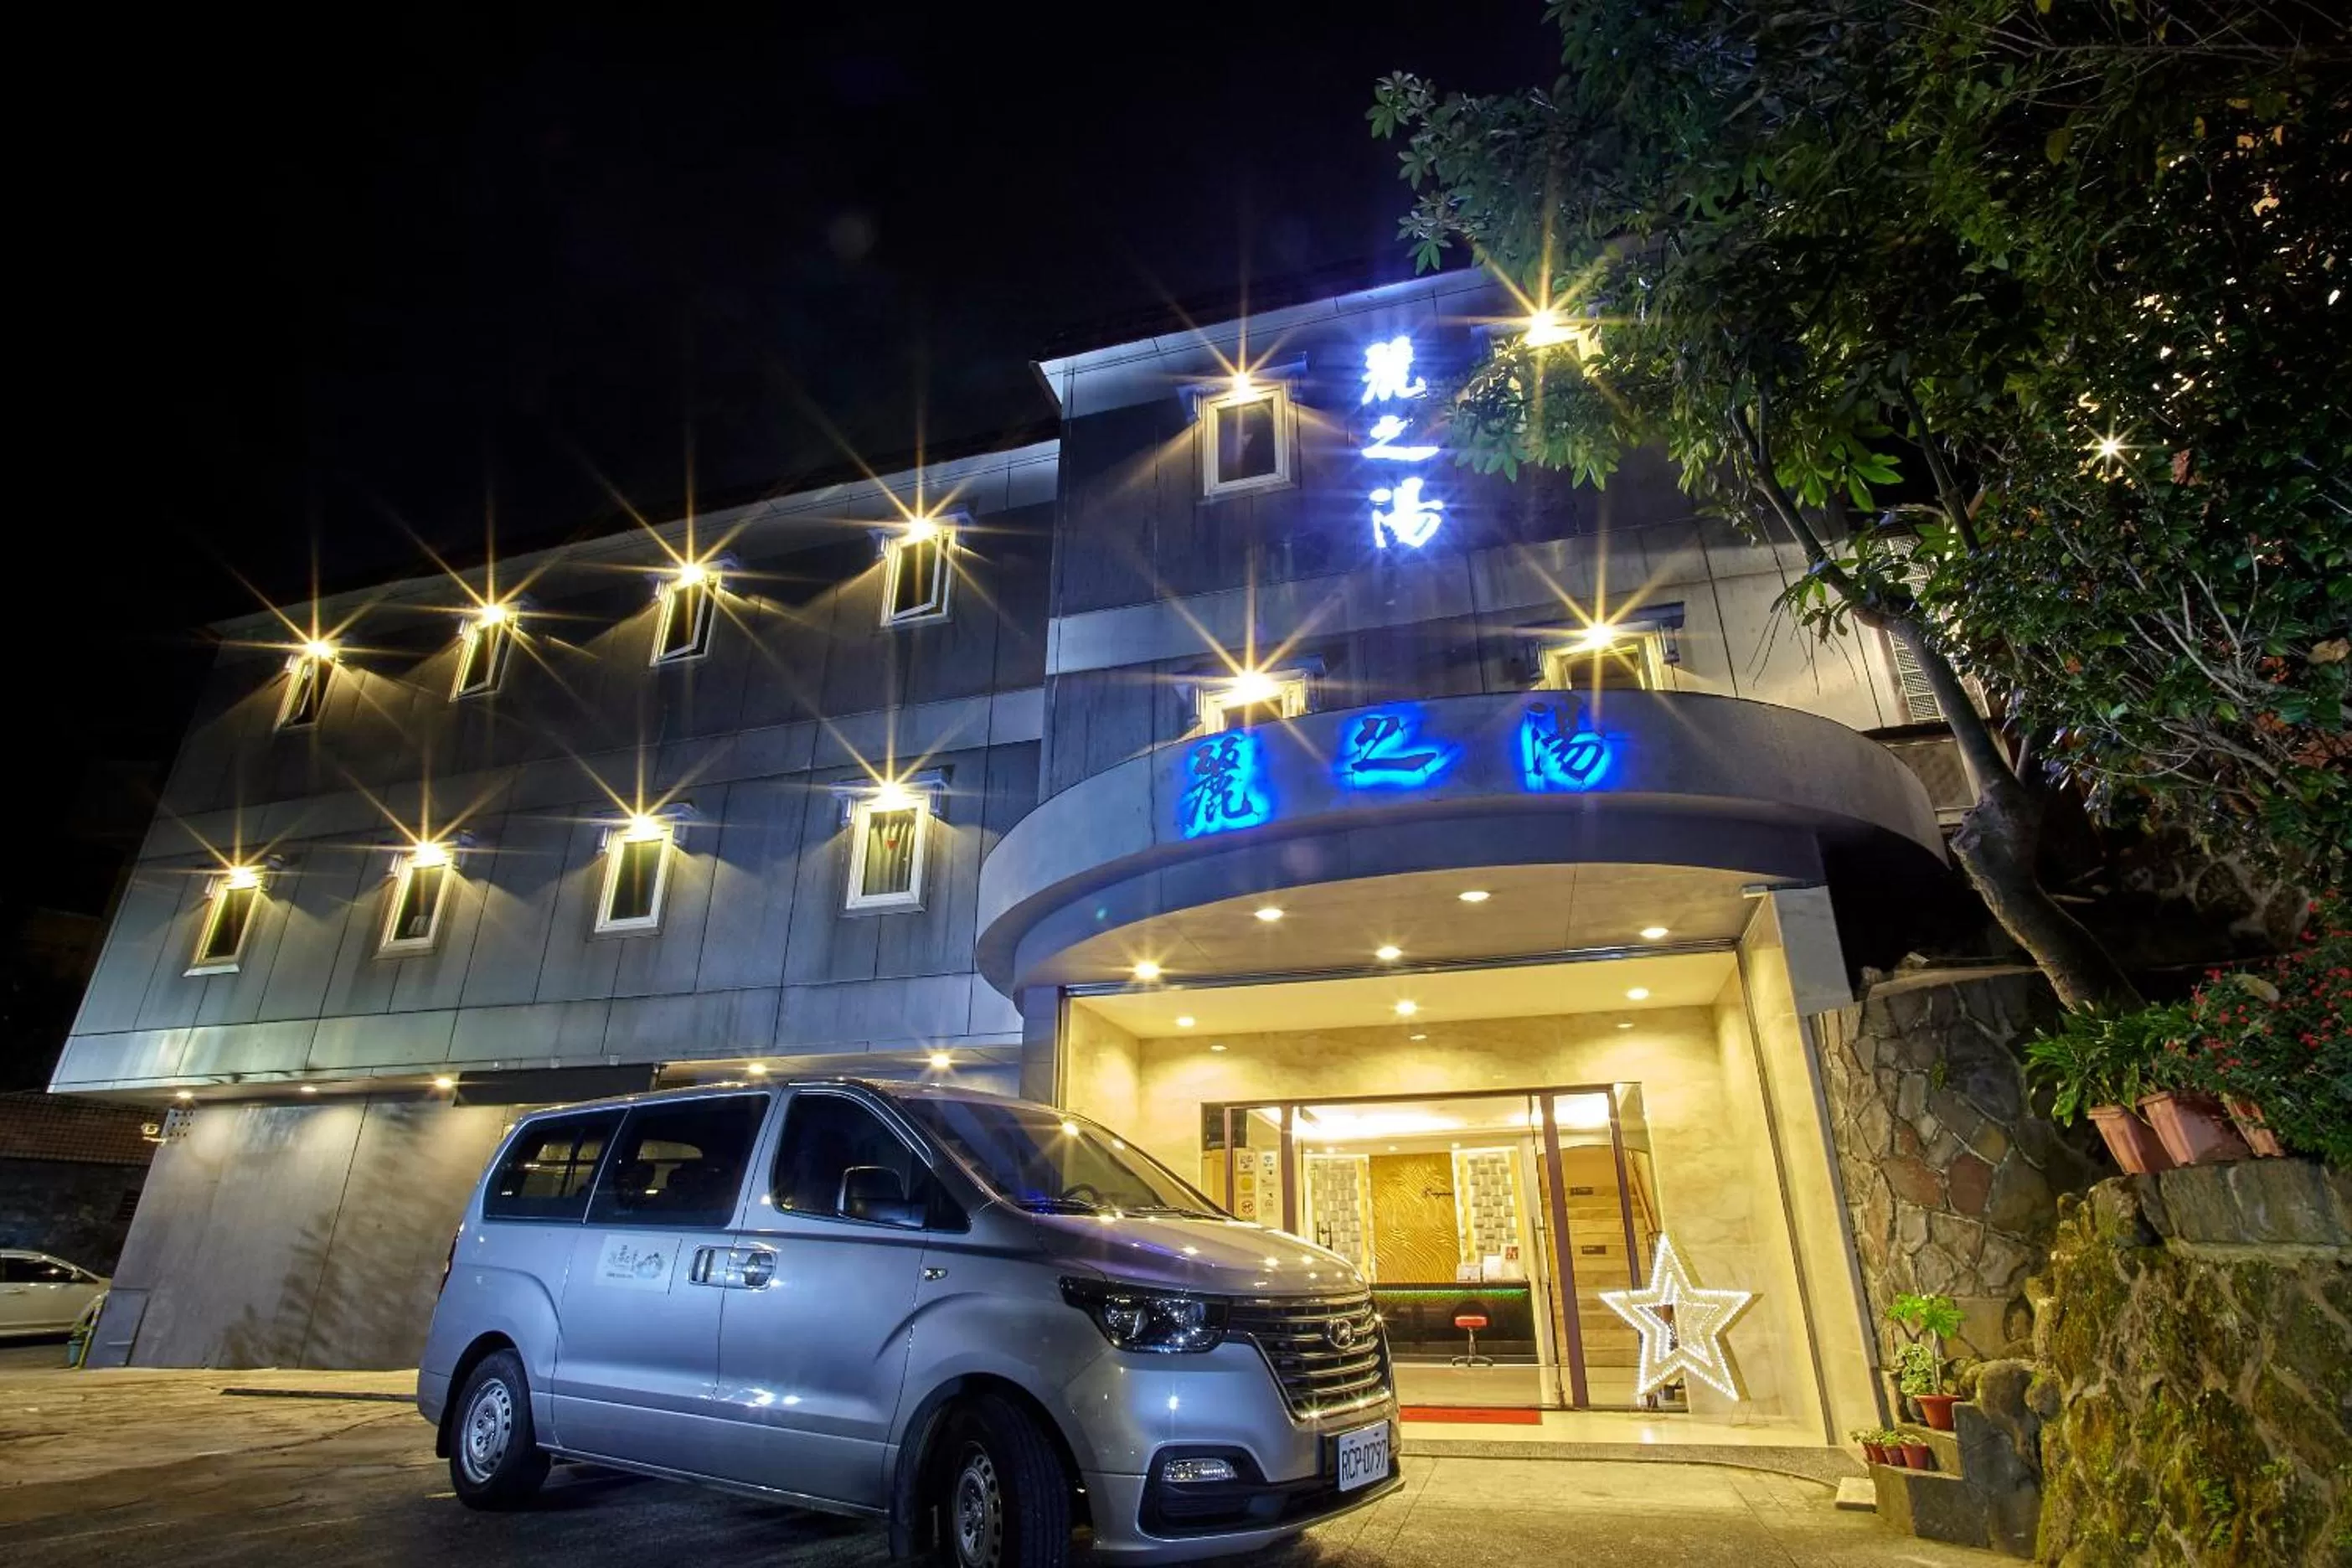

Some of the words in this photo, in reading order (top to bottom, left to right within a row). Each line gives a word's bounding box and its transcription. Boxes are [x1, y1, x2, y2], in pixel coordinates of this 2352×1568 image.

[1186, 694, 1607, 829] 麗之湯
[1342, 1440, 1386, 1481] RCP-0797
